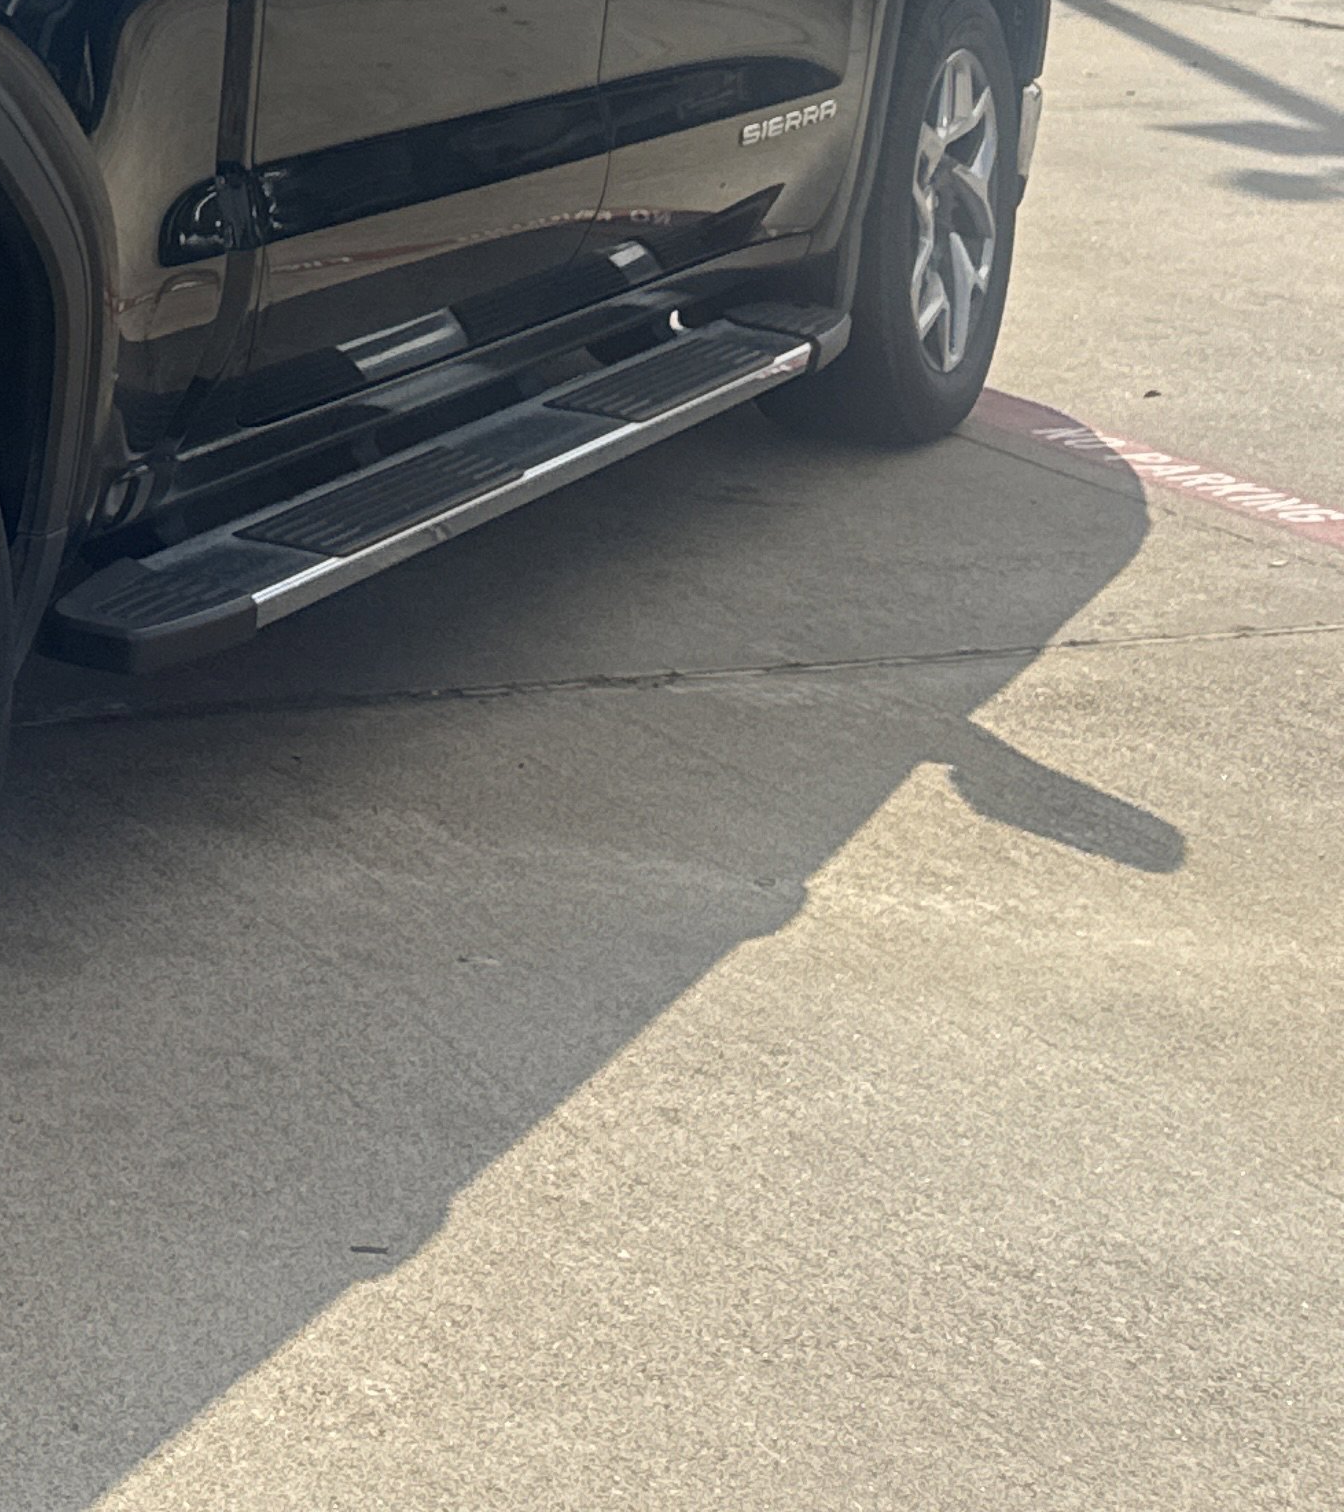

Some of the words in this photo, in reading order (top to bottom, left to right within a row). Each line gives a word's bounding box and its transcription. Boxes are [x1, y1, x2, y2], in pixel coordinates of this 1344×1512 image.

[739, 99, 838, 147] SIERRA
[1032, 427, 1127, 451] NO
[1103, 451, 1344, 523] PARKING
